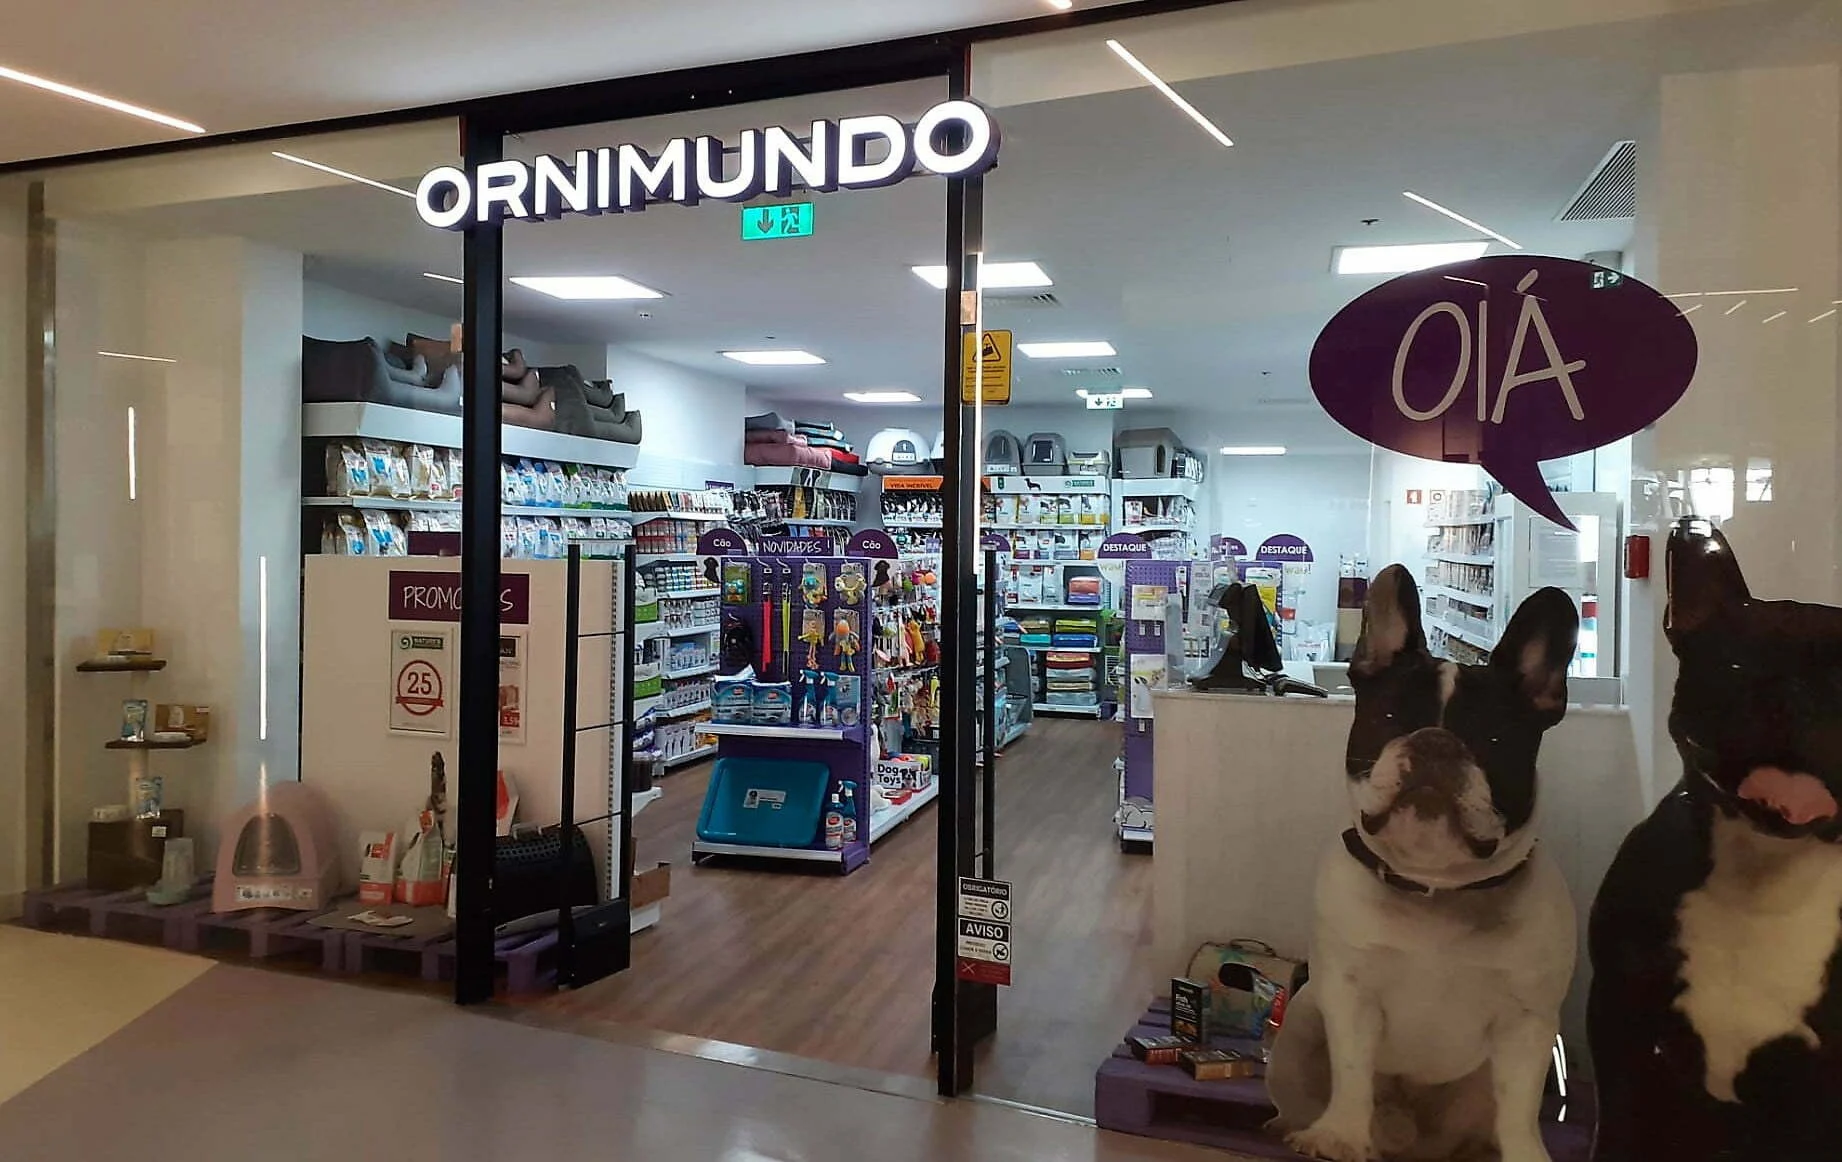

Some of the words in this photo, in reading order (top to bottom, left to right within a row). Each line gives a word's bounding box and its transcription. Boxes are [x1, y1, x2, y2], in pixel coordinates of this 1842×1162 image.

[415, 100, 991, 229] ORNIMUNDO
[713, 538, 732, 547] Cão
[763, 540, 823, 554] NOVIDADES
[862, 540, 881, 549] Cão
[1103, 543, 1147, 552] DESTAQUE
[1260, 545, 1308, 555] DESTAQUE
[403, 586, 514, 612] PROMOS
[407, 671, 432, 695] 25
[877, 763, 899, 776] Dog
[878, 774, 901, 785] Toys
[965, 923, 1004, 939] AVISO
